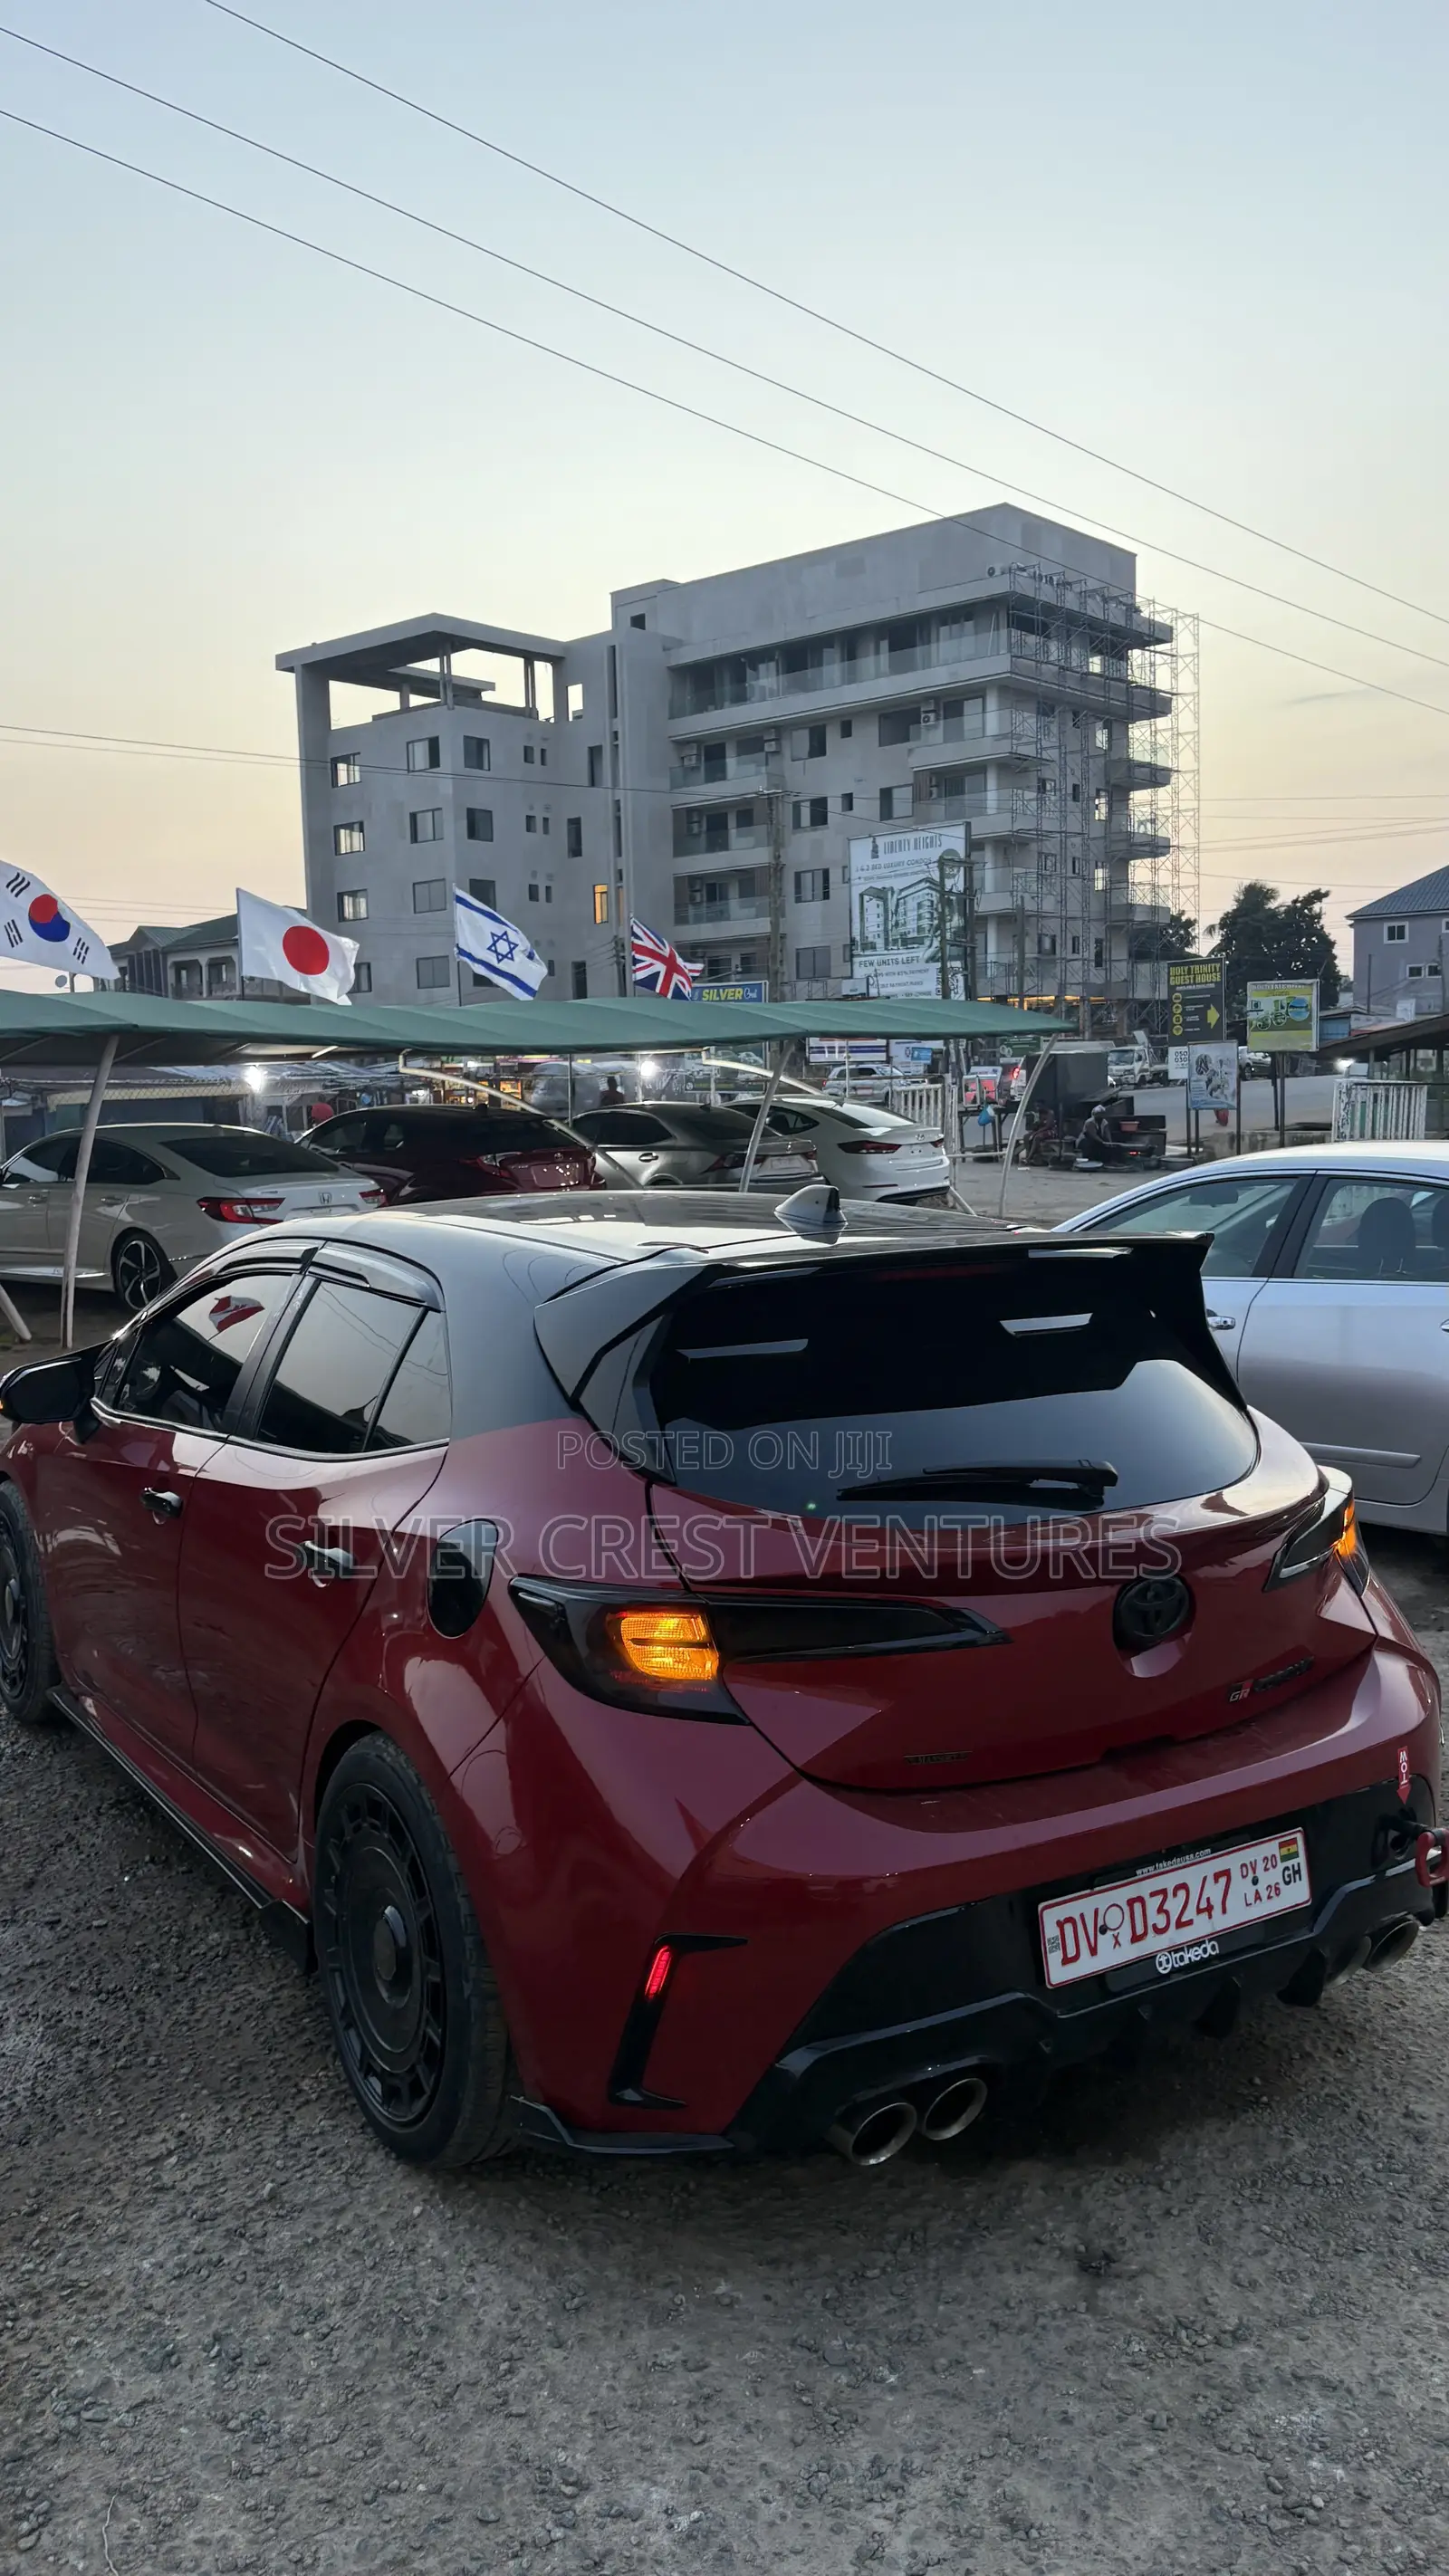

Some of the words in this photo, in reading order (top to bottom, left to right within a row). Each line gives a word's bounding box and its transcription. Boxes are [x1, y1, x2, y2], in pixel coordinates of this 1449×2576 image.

[883, 838, 910, 854] LIBERTY
[913, 834, 942, 850] HEIGHTS
[906, 857, 932, 867] CONDOS
[859, 960, 875, 968] FEW
[877, 957, 900, 967] UNITS
[901, 955, 920, 964] LEFT
[1169, 966, 1188, 975] HOLY
[1190, 963, 1220, 973] TRINITY
[1169, 975, 1194, 985] GUEST
[1195, 973, 1221, 982] HOUSE
[702, 988, 743, 1001] SILVER
[1229, 1687, 1251, 1702] GR
[1136, 1848, 1212, 1876] www.takedausa.com
[1240, 1859, 1258, 1879] DV
[1262, 1853, 1278, 1873] 20
[1281, 1862, 1302, 1886] GH
[1244, 1892, 1263, 1908] LA
[1266, 1882, 1281, 1901] 26
[1056, 1908, 1099, 1966] DV
[1127, 1868, 1232, 1944] D3247
[1171, 1939, 1219, 1968] takeda
